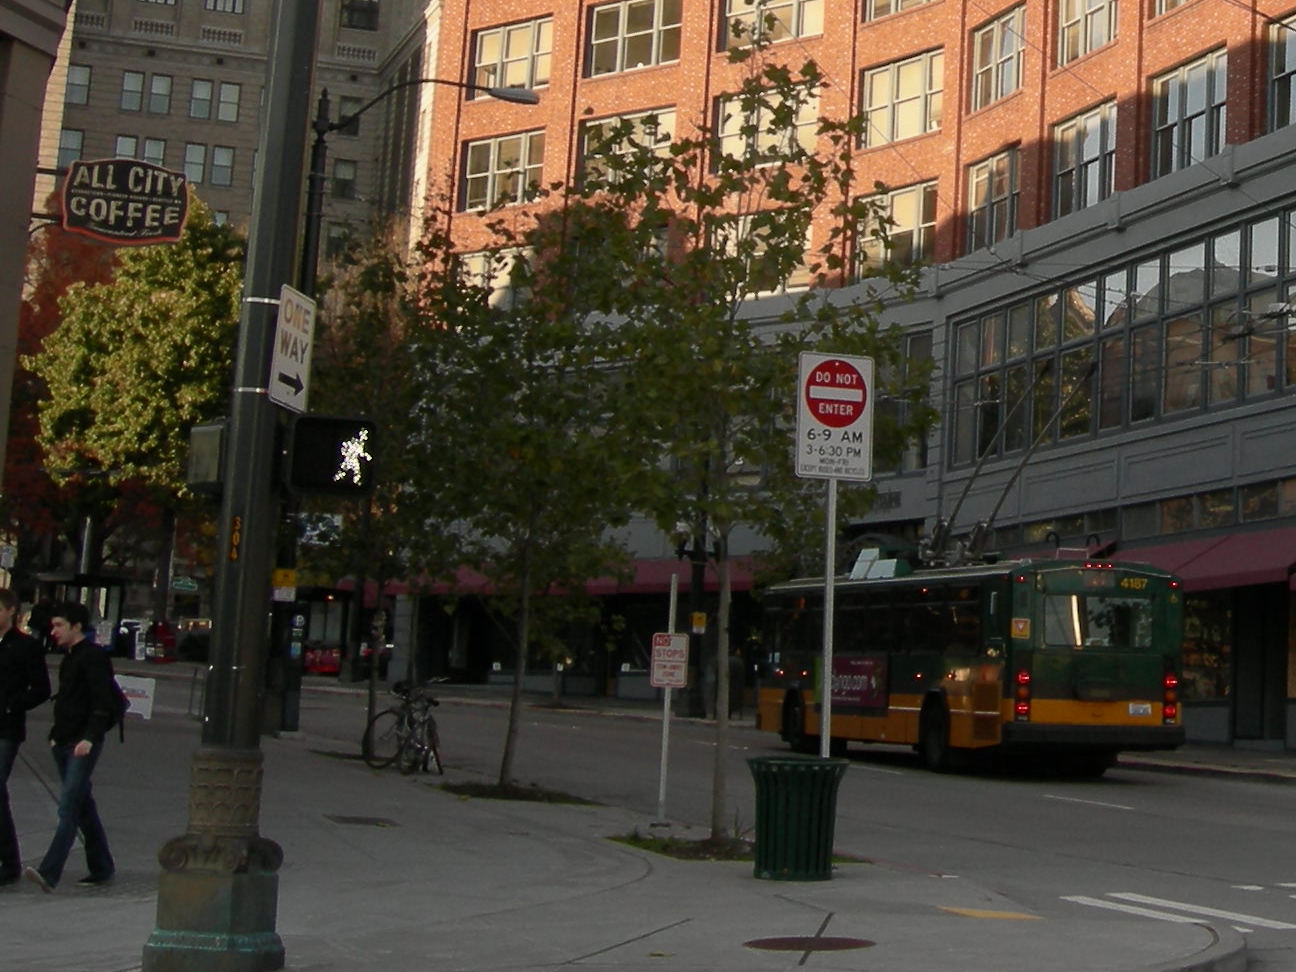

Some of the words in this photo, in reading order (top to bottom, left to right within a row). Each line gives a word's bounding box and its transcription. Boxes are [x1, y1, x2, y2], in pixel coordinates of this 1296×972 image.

[73, 164, 117, 190] ALL
[128, 166, 184, 197] CITY
[70, 196, 180, 227] COFFEE
[283, 298, 312, 336] ONE
[280, 328, 309, 365] WAY
[815, 371, 831, 383] DO
[836, 373, 858, 385] NOT
[818, 402, 854, 416] ENTER
[807, 428, 832, 441] 6-9
[841, 430, 863, 443] AM
[846, 447, 861, 458] PM
[1120, 578, 1148, 590] 4187
[655, 636, 669, 646] NO
